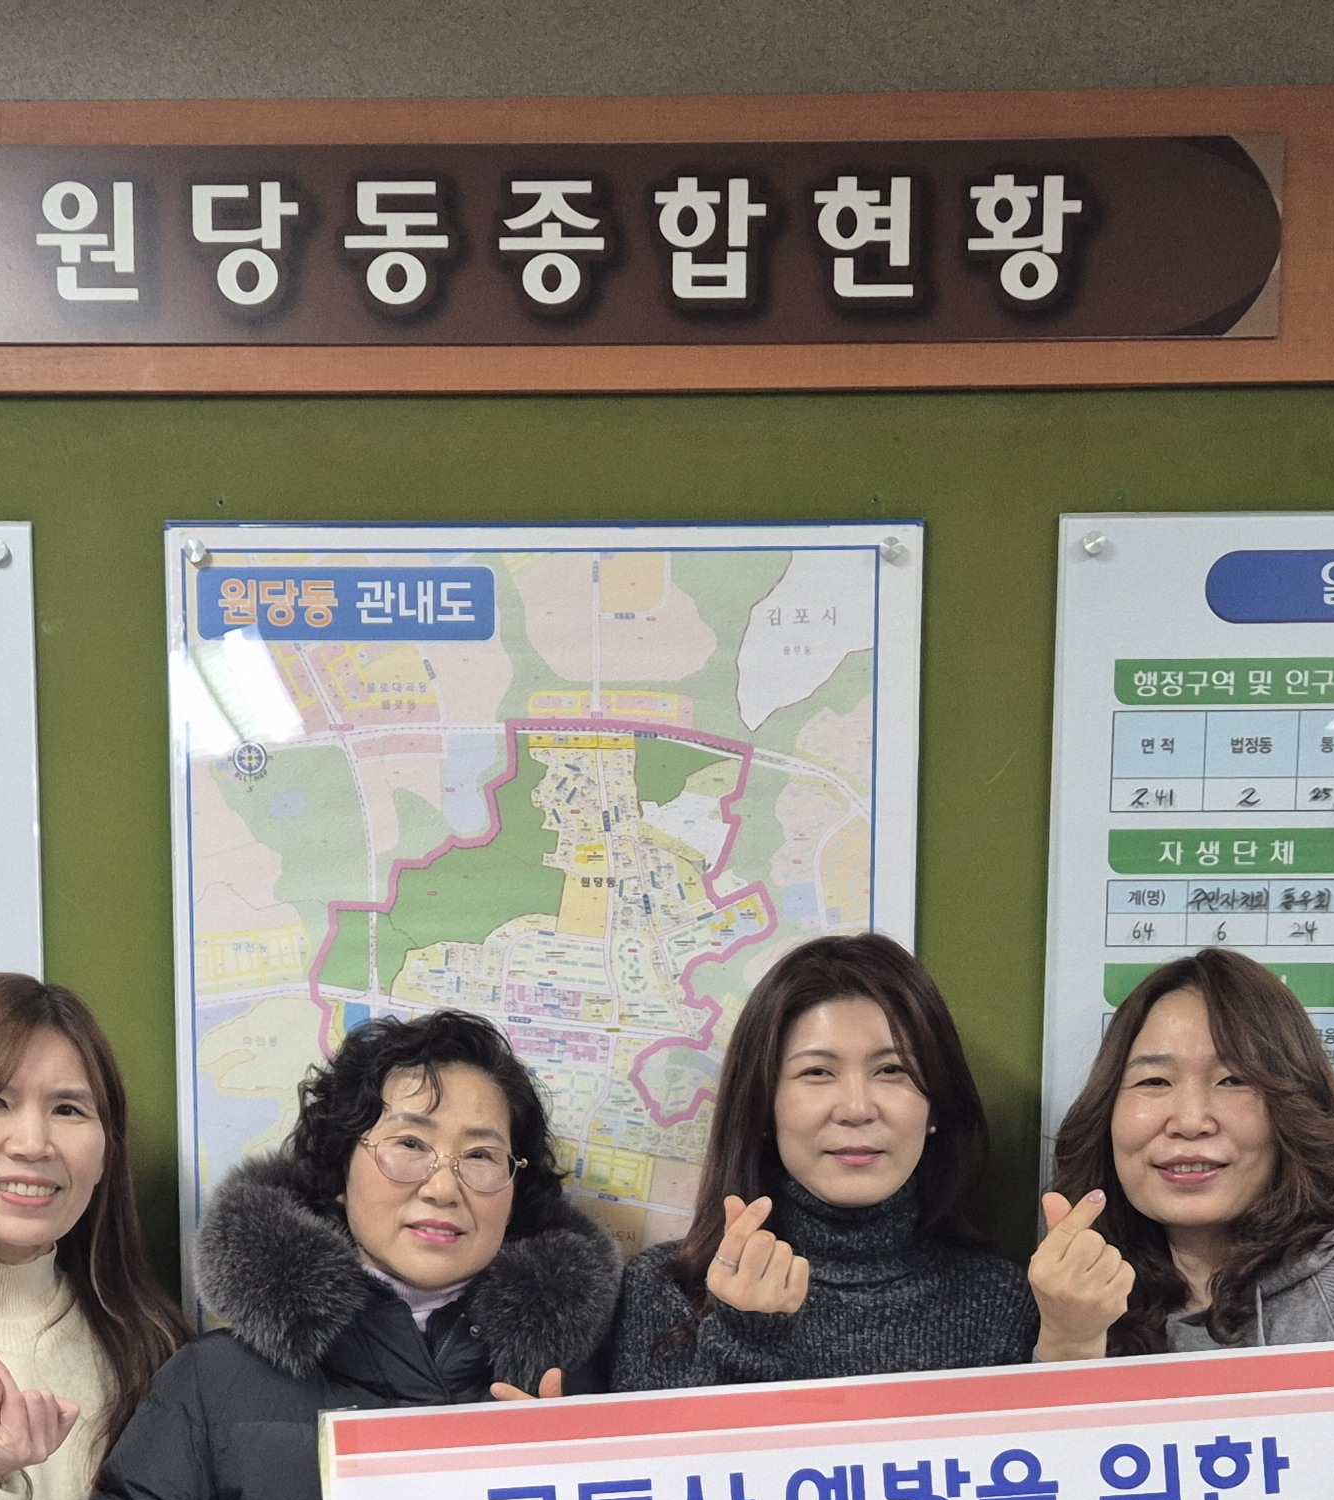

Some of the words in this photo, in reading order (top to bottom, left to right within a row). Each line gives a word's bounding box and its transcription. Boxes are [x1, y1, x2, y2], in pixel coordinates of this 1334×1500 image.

[36, 174, 1082, 307] 원당동종합현황
[218, 578, 338, 628] 원당동
[356, 580, 476, 625] 관내도
[766, 607, 837, 626] 김포시
[1133, 669, 1236, 696] 행정구역
[1249, 669, 1272, 696] 및
[1286, 669, 1334, 695] 인구
[1230, 737, 1273, 754] 법정동
[1130, 788, 1175, 807] 2.41
[1238, 788, 1261, 807] 2
[1128, 889, 1166, 907] 계(명)
[1132, 921, 1155, 940] 64
[1217, 921, 1227, 941] 6
[1291, 921, 1318, 941] 24
